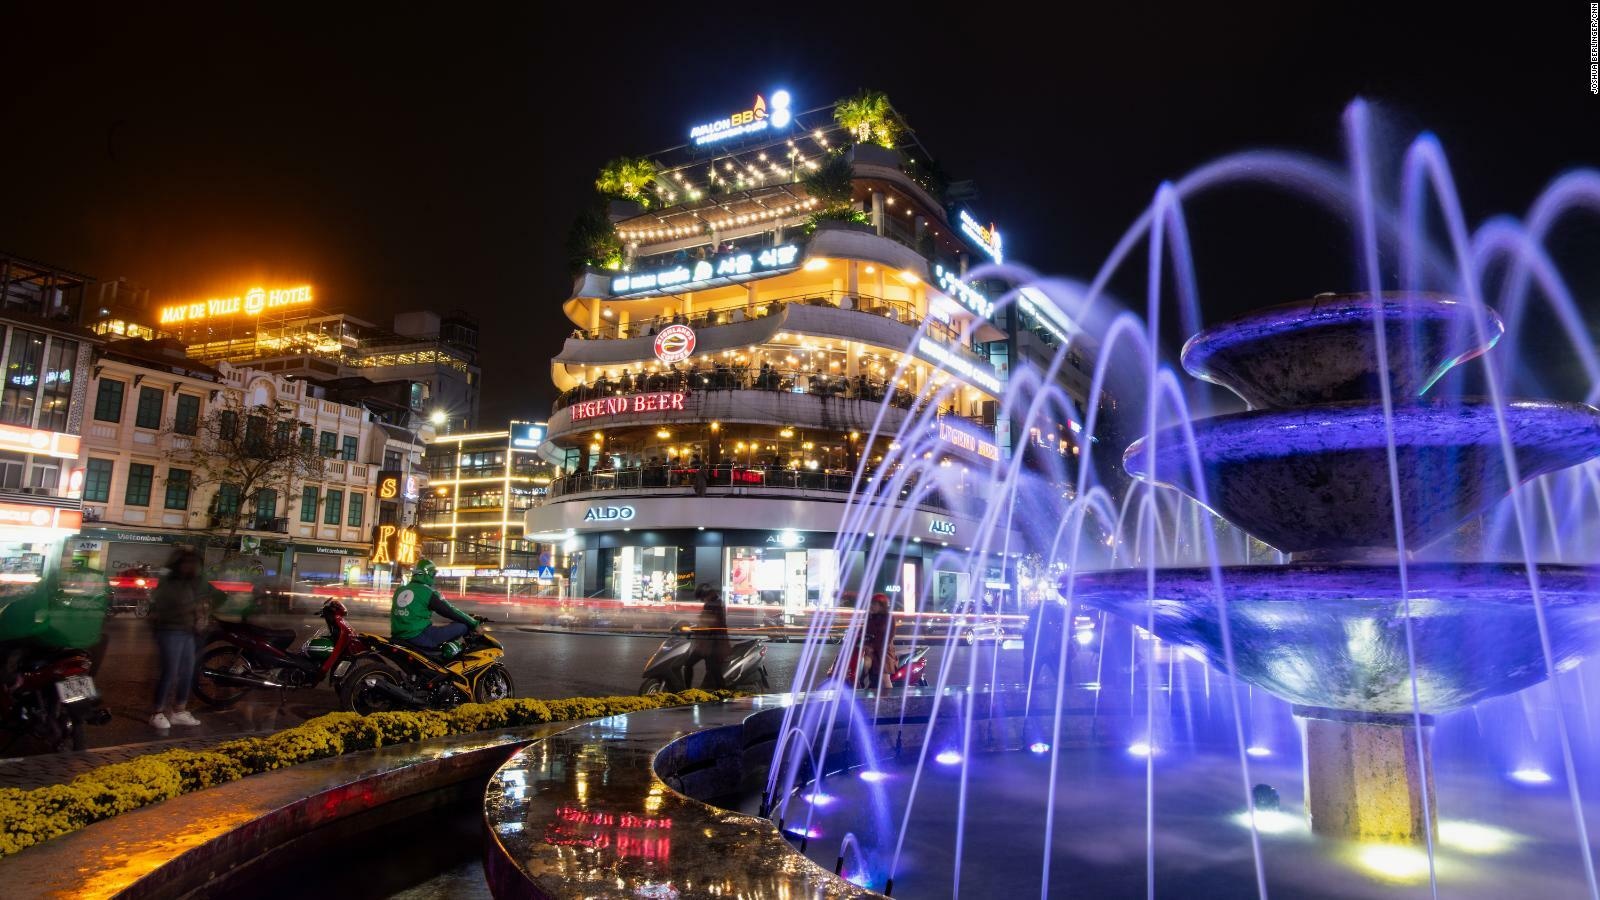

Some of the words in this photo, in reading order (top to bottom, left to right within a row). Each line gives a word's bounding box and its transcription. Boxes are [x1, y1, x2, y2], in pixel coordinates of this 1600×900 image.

[690, 118, 730, 138] AVALON
[161, 307, 187, 323] MAY
[189, 303, 206, 318] DE
[208, 297, 241, 315] VILLE
[269, 286, 312, 306] HOTEL
[656, 327, 694, 344] HIGHLANDS
[571, 397, 628, 420] LEGEND
[634, 393, 684, 412] BEER
[584, 505, 636, 522] ALDO
[928, 519, 956, 536] ALDO
[79, 541, 98, 549] ATM
[117, 532, 164, 543] Vietcombank
[766, 534, 806, 544] ALO
[316, 546, 348, 556] Vietcombank
